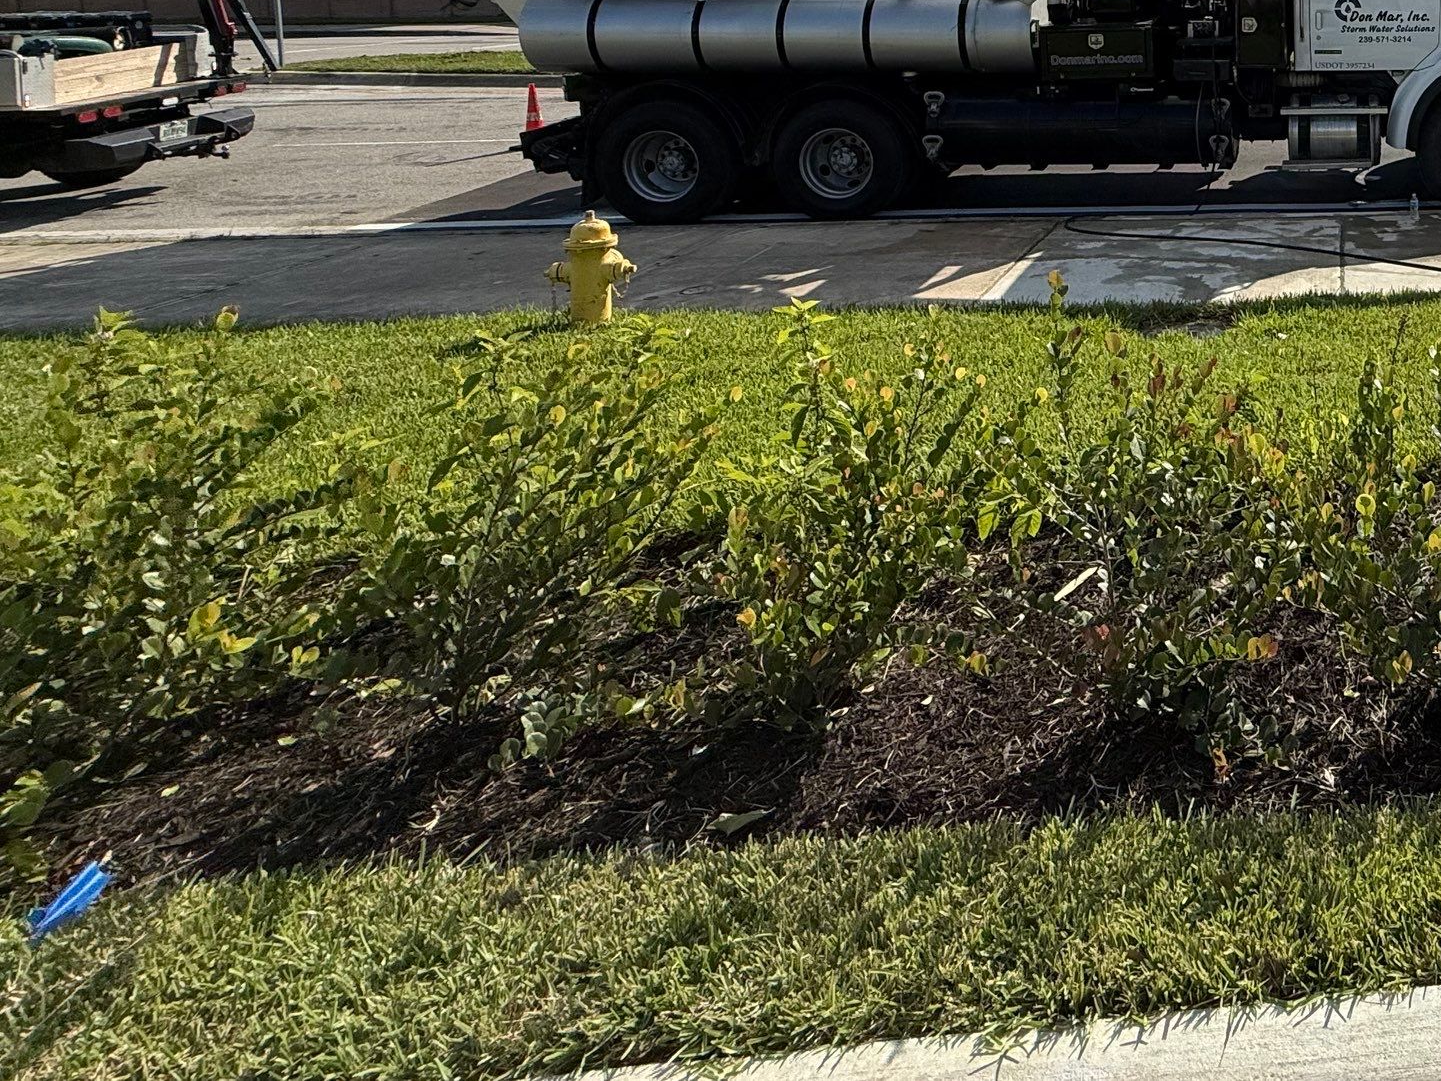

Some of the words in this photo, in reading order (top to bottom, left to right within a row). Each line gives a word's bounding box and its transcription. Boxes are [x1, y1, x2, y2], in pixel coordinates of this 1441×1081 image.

[1349, 10, 1373, 22] Don
[1376, 10, 1404, 23] Mar,
[1407, 10, 1430, 22] Inc.
[1340, 25, 1366, 33] Storm
[1369, 25, 1394, 33] Water
[1395, 24, 1436, 33] Solutions
